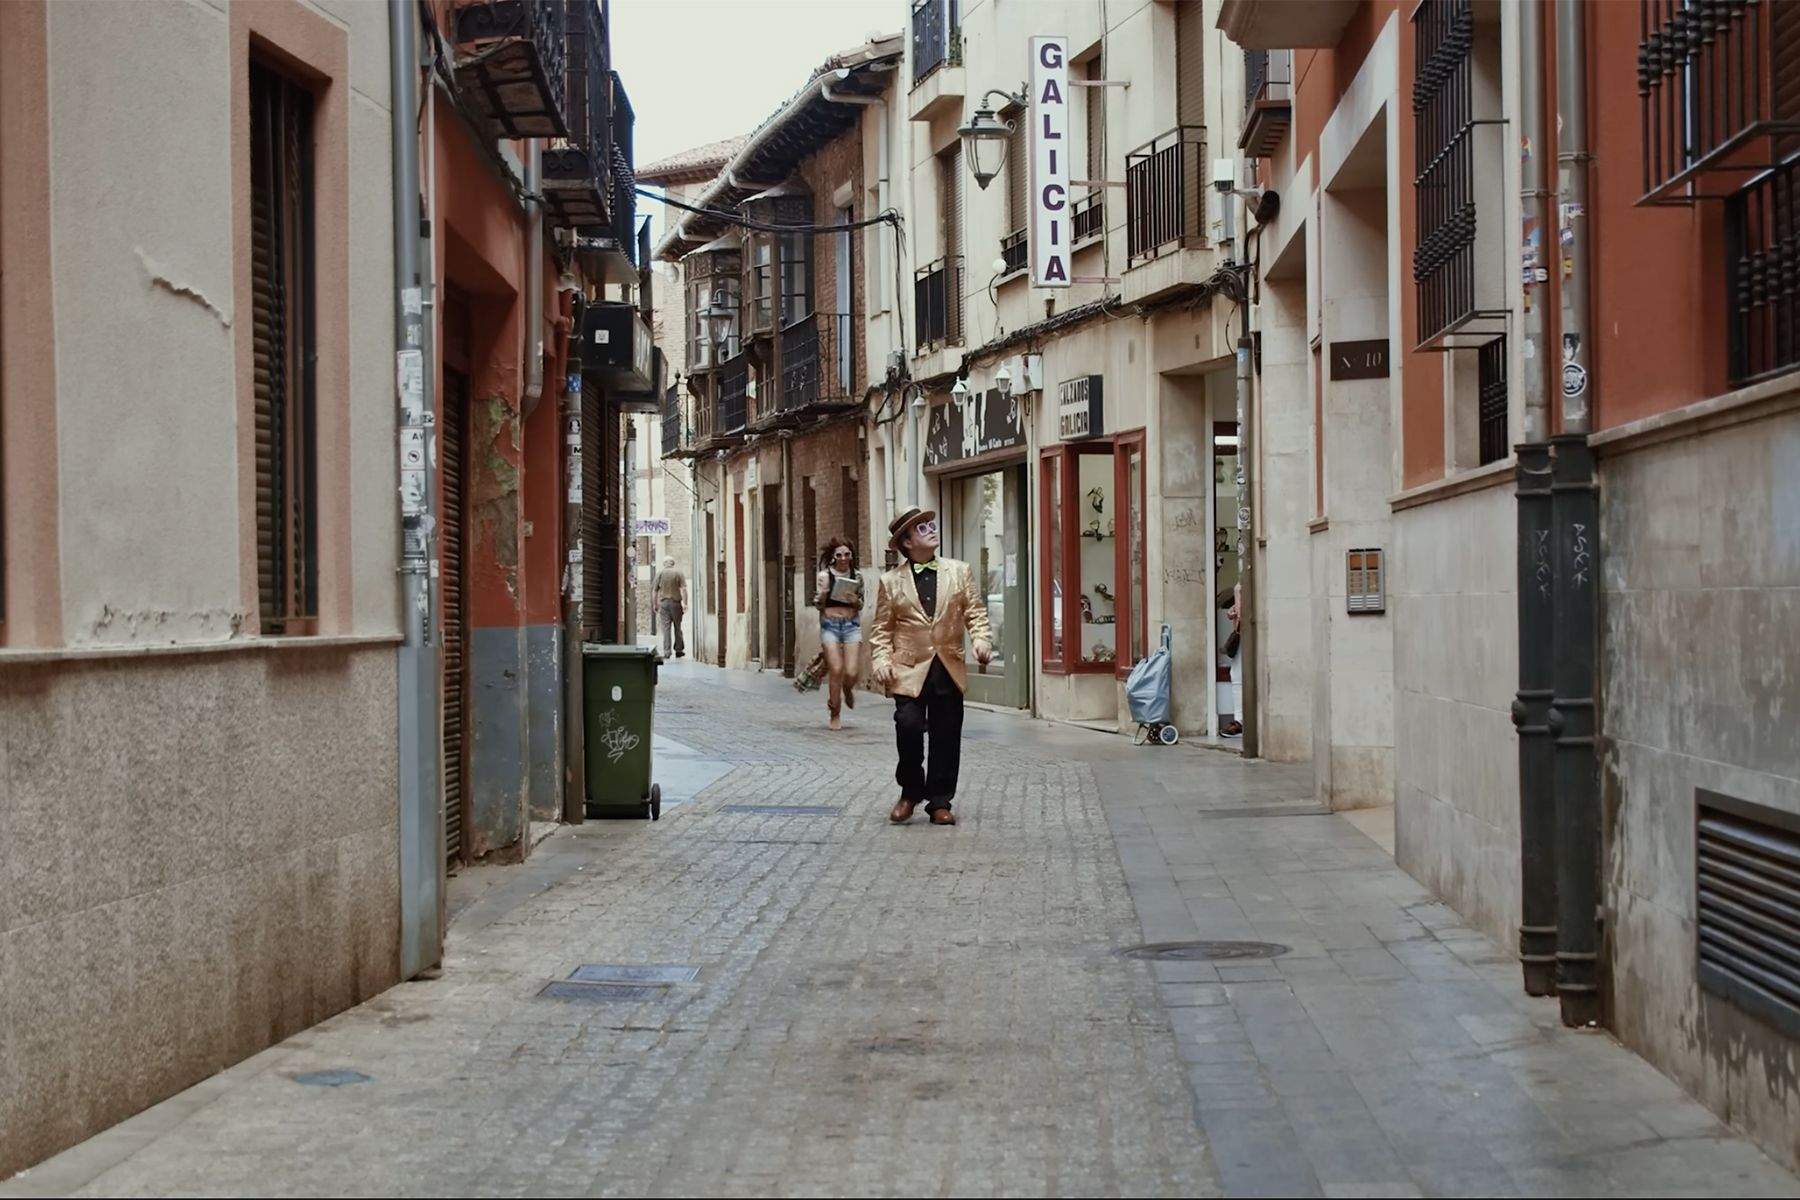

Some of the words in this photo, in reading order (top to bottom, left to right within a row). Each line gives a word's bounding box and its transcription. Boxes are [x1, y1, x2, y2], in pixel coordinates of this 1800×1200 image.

[1040, 43, 1067, 282] GALICIA
[1366, 352, 1382, 367] 10
[1061, 411, 1088, 437] GALICIA
